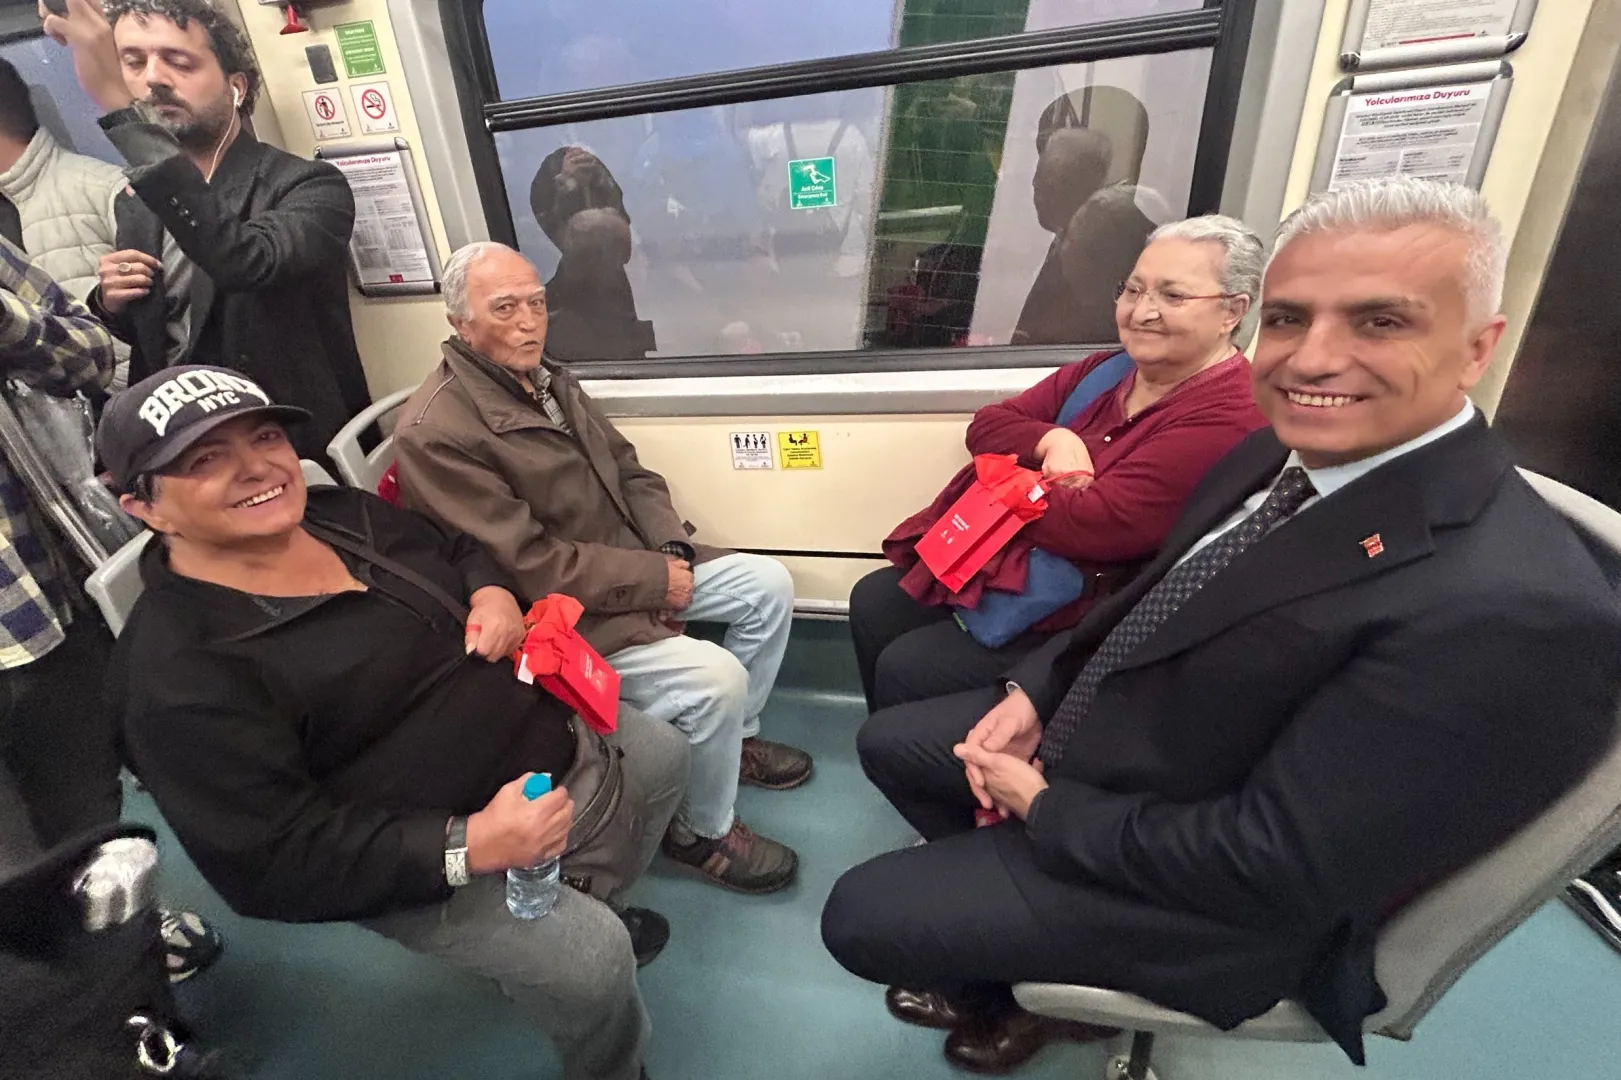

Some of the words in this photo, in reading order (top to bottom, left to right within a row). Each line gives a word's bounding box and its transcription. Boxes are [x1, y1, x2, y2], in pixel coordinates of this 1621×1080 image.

[1365, 94, 1431, 106] Yolcularımıza
[1433, 89, 1471, 99] Duyuru
[197, 391, 241, 413] NYC
